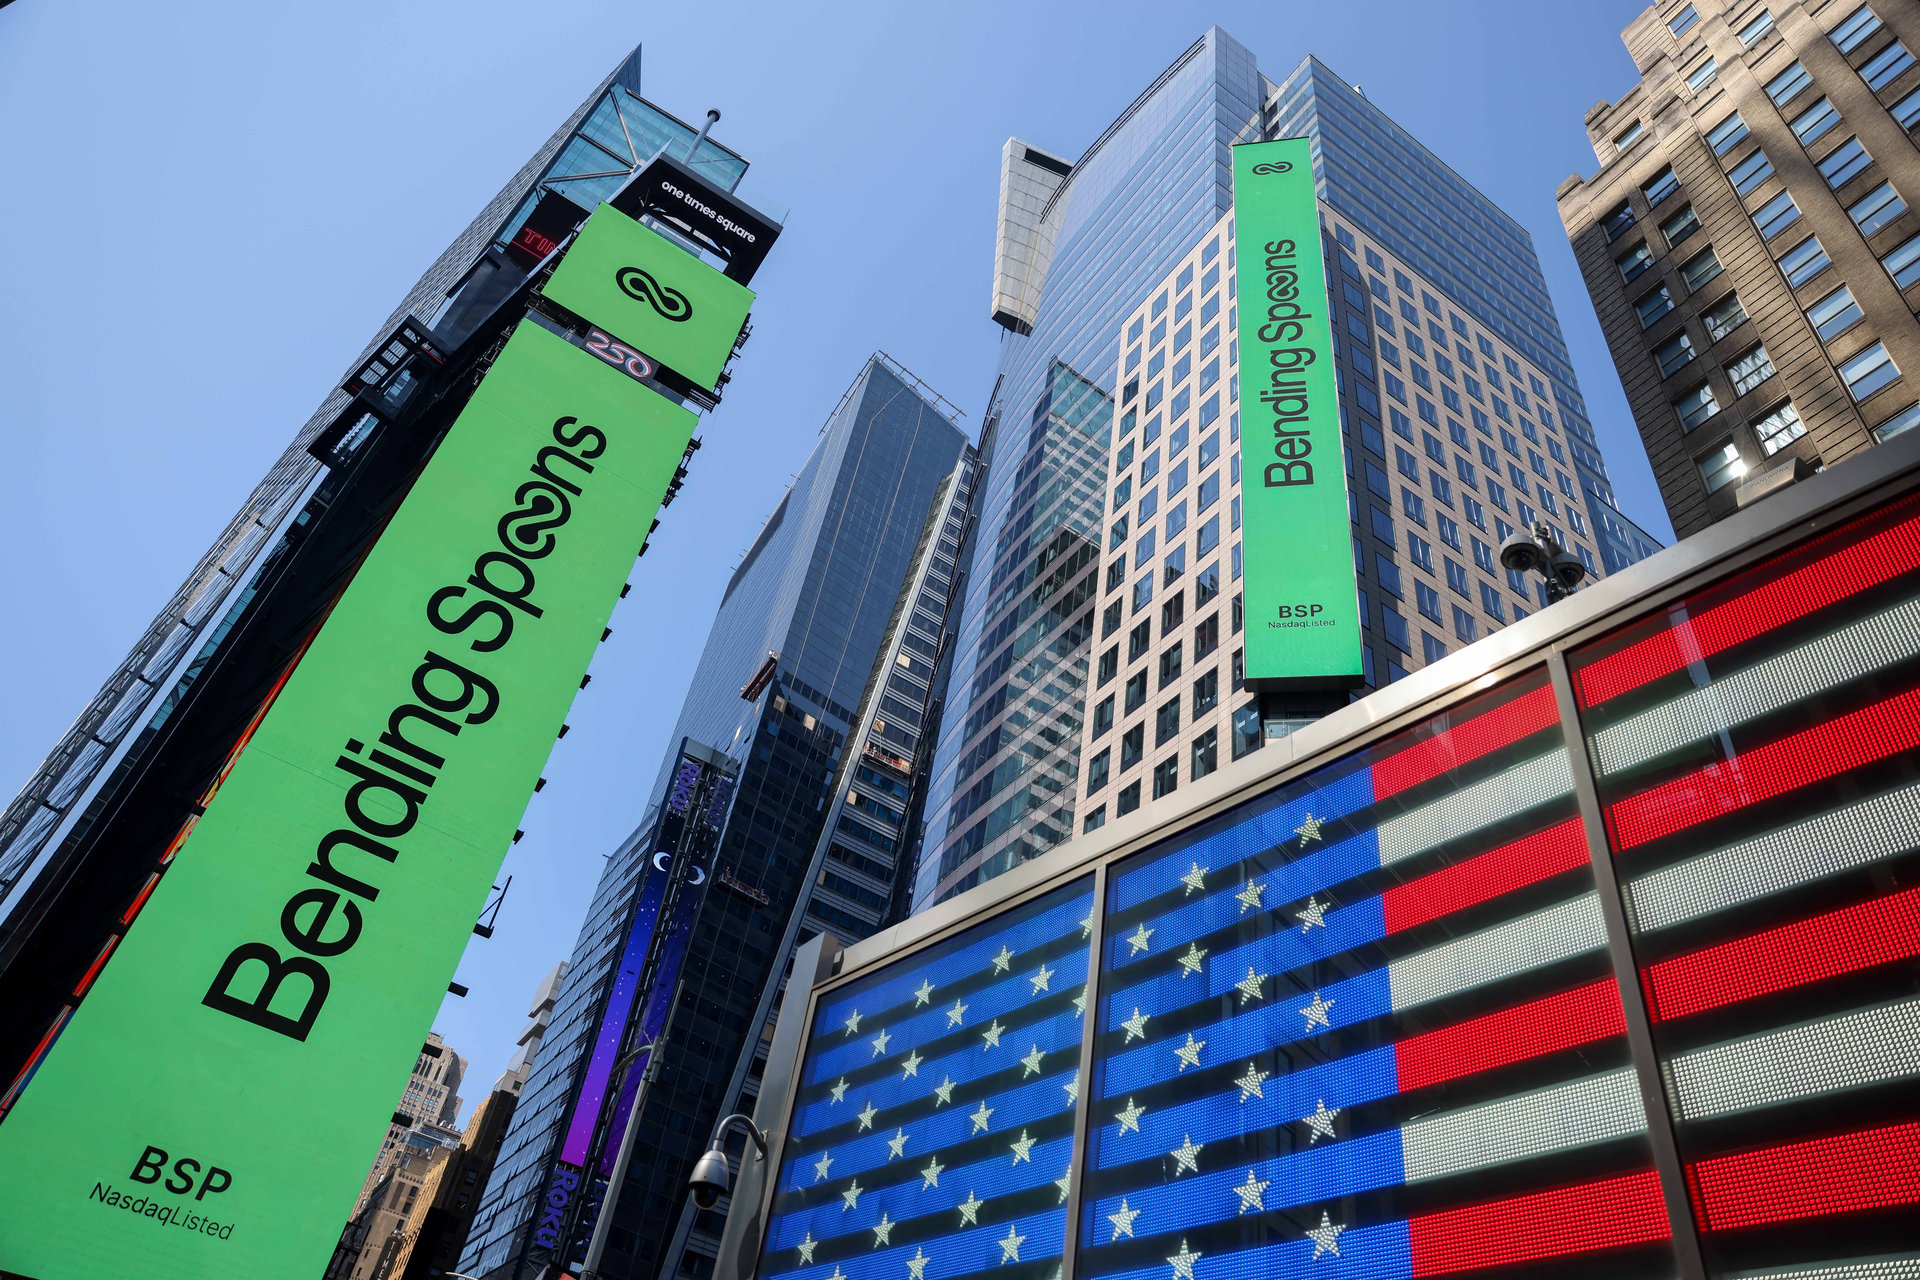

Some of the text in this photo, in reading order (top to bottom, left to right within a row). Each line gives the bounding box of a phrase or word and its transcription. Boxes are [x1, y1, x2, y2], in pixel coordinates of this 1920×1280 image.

[661, 180, 756, 243] one times square
[586, 331, 652, 378] 250
[1258, 239, 1316, 488] Bending Spoons
[1268, 619, 1336, 630] NasdaqListed
[1278, 603, 1324, 619] BSP
[201, 415, 607, 1043] Bending Spoons
[128, 1144, 233, 1202] BSP
[88, 1181, 236, 1241] NasdaqListed
[377, 1241, 396, 1280] TIME
